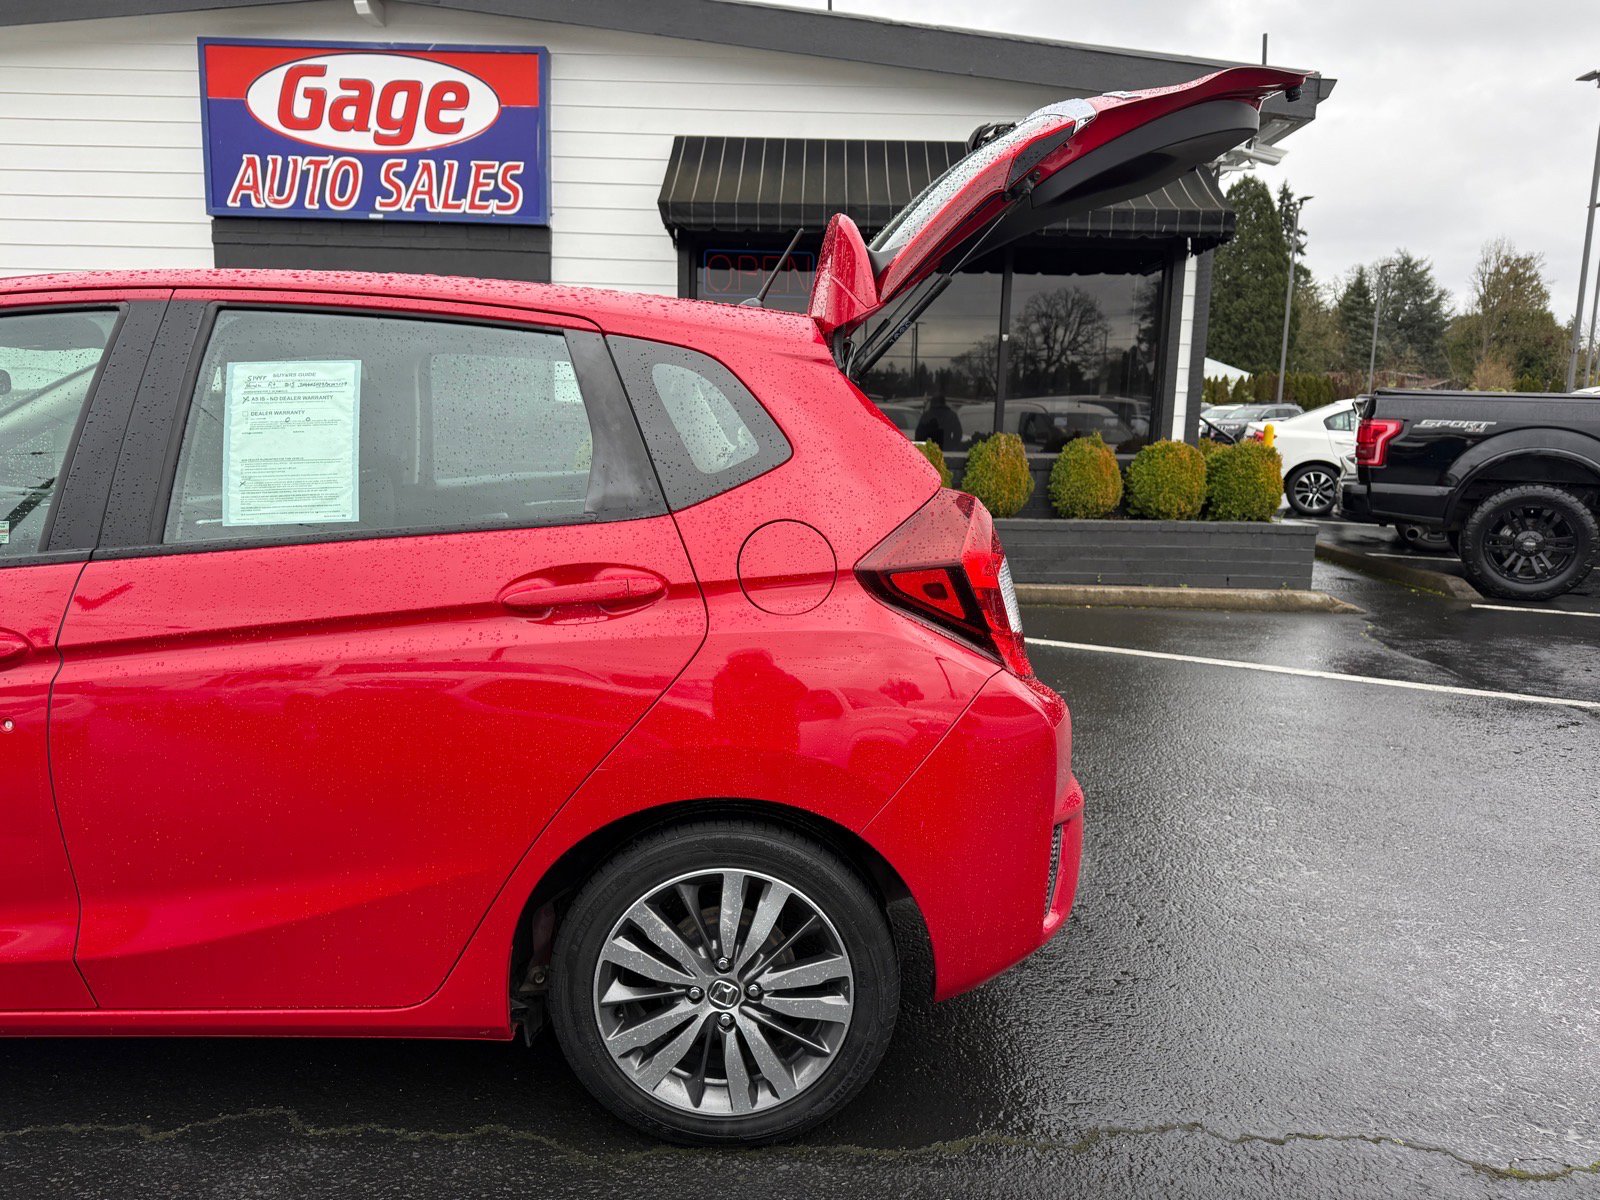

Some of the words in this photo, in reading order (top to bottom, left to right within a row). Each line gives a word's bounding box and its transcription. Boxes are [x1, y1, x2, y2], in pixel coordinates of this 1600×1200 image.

[277, 63, 470, 146] Gage
[227, 154, 363, 211] AUTO
[375, 157, 525, 215] SALES
[707, 254, 811, 293] OPEN
[1412, 419, 1497, 429] SPORT
